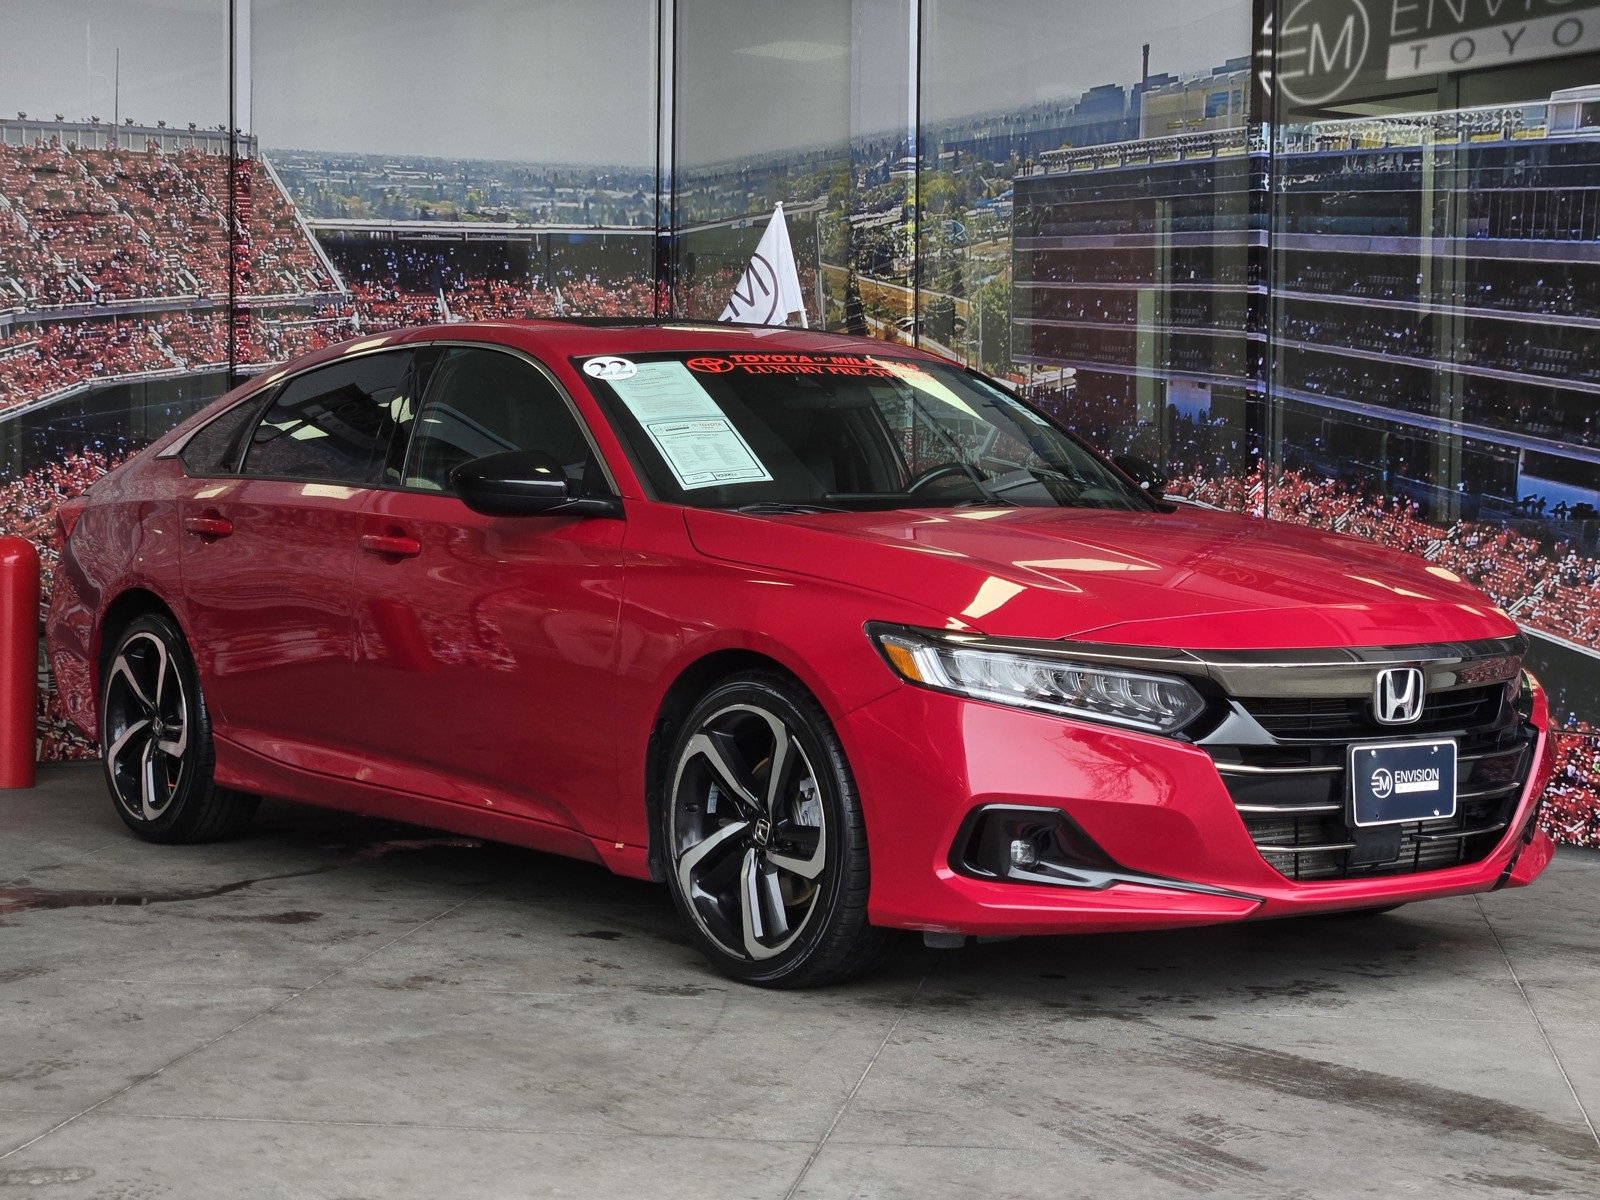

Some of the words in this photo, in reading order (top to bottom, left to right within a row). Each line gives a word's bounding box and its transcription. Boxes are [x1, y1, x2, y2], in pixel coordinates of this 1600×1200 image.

[729, 354, 814, 363] TOYOTA
[589, 361, 633, 376] 22
[741, 365, 824, 374] LUXURY
[1395, 768, 1439, 783] ENVISION
